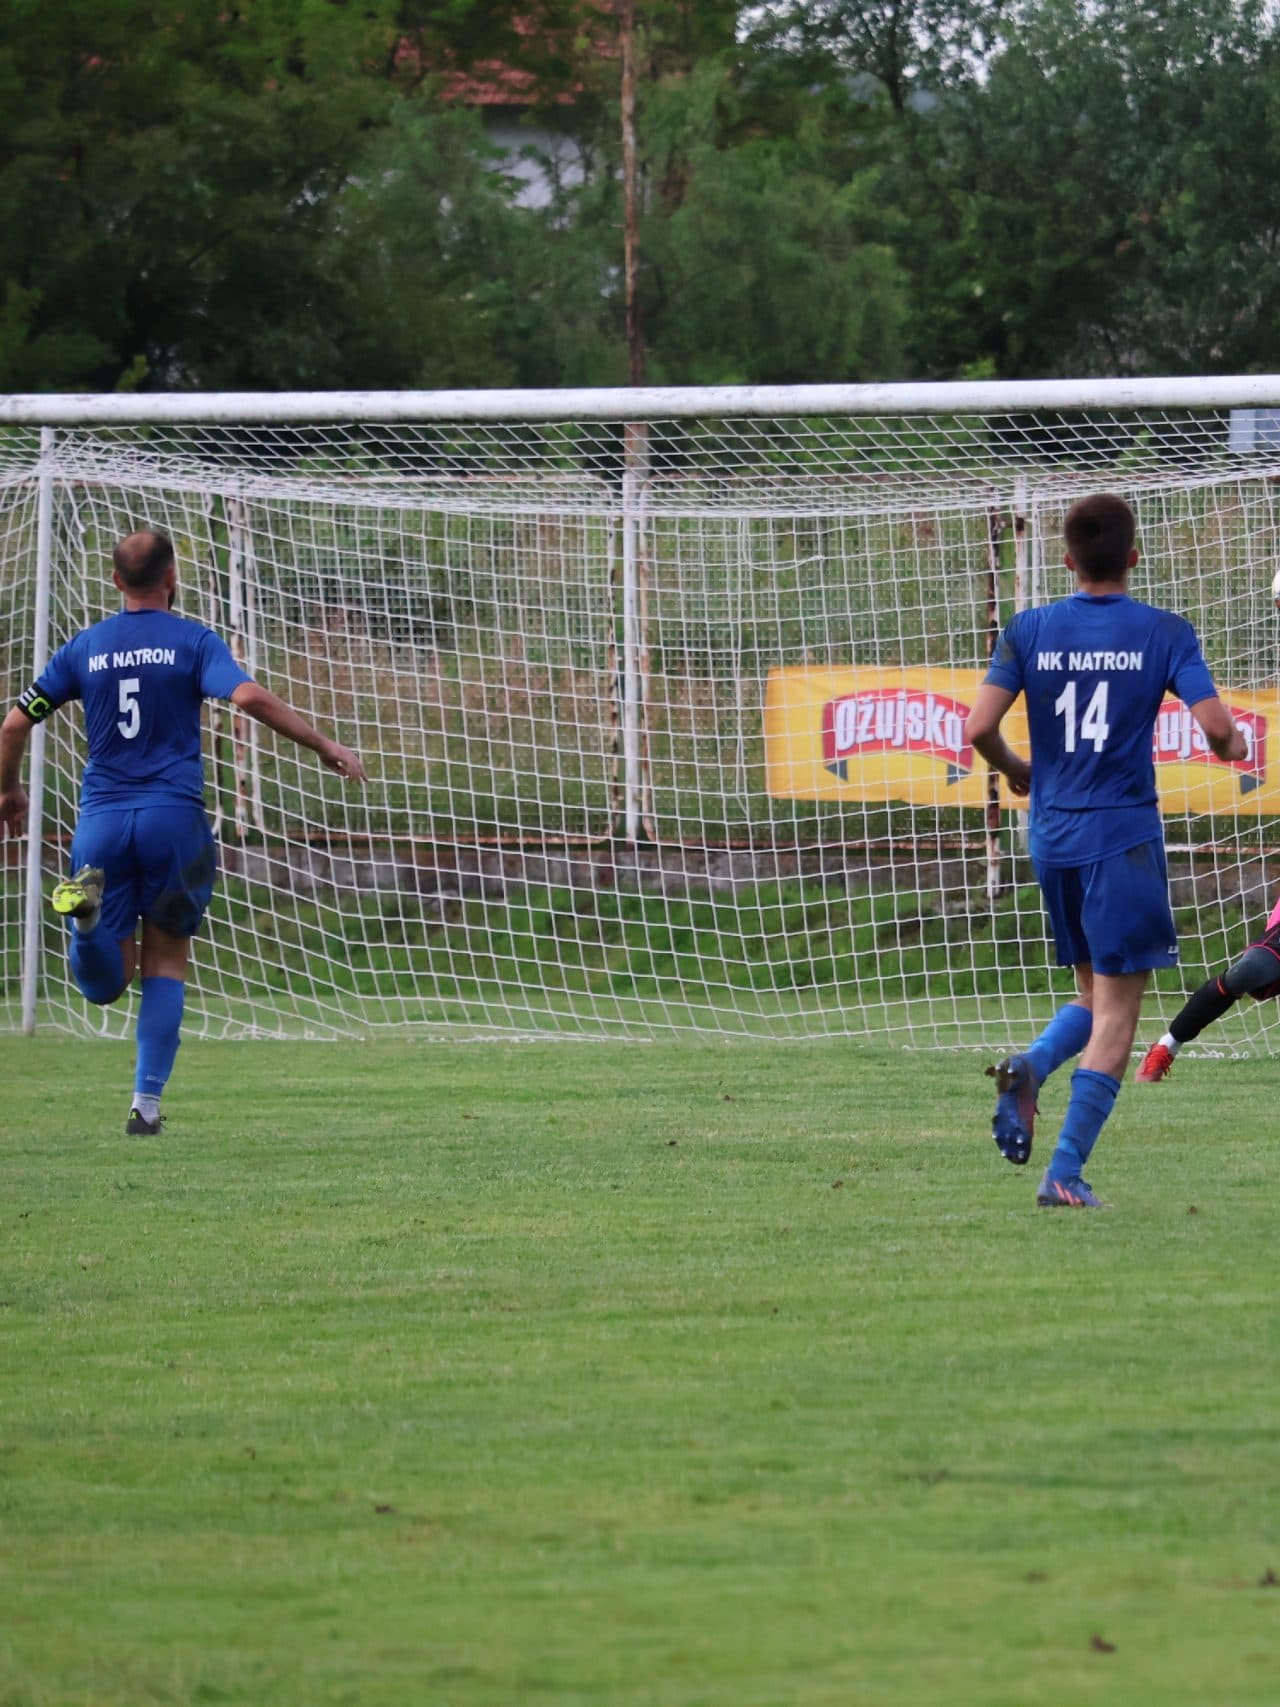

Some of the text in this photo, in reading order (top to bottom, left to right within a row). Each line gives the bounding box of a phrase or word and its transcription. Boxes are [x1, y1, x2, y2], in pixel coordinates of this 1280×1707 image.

[88, 648, 175, 673] NK NATRON
[1037, 651, 1143, 671] NK NATRON
[28, 696, 50, 718] C
[117, 677, 141, 740] 5
[836, 691, 963, 752] Ožujsko
[1055, 681, 1109, 753] 14
